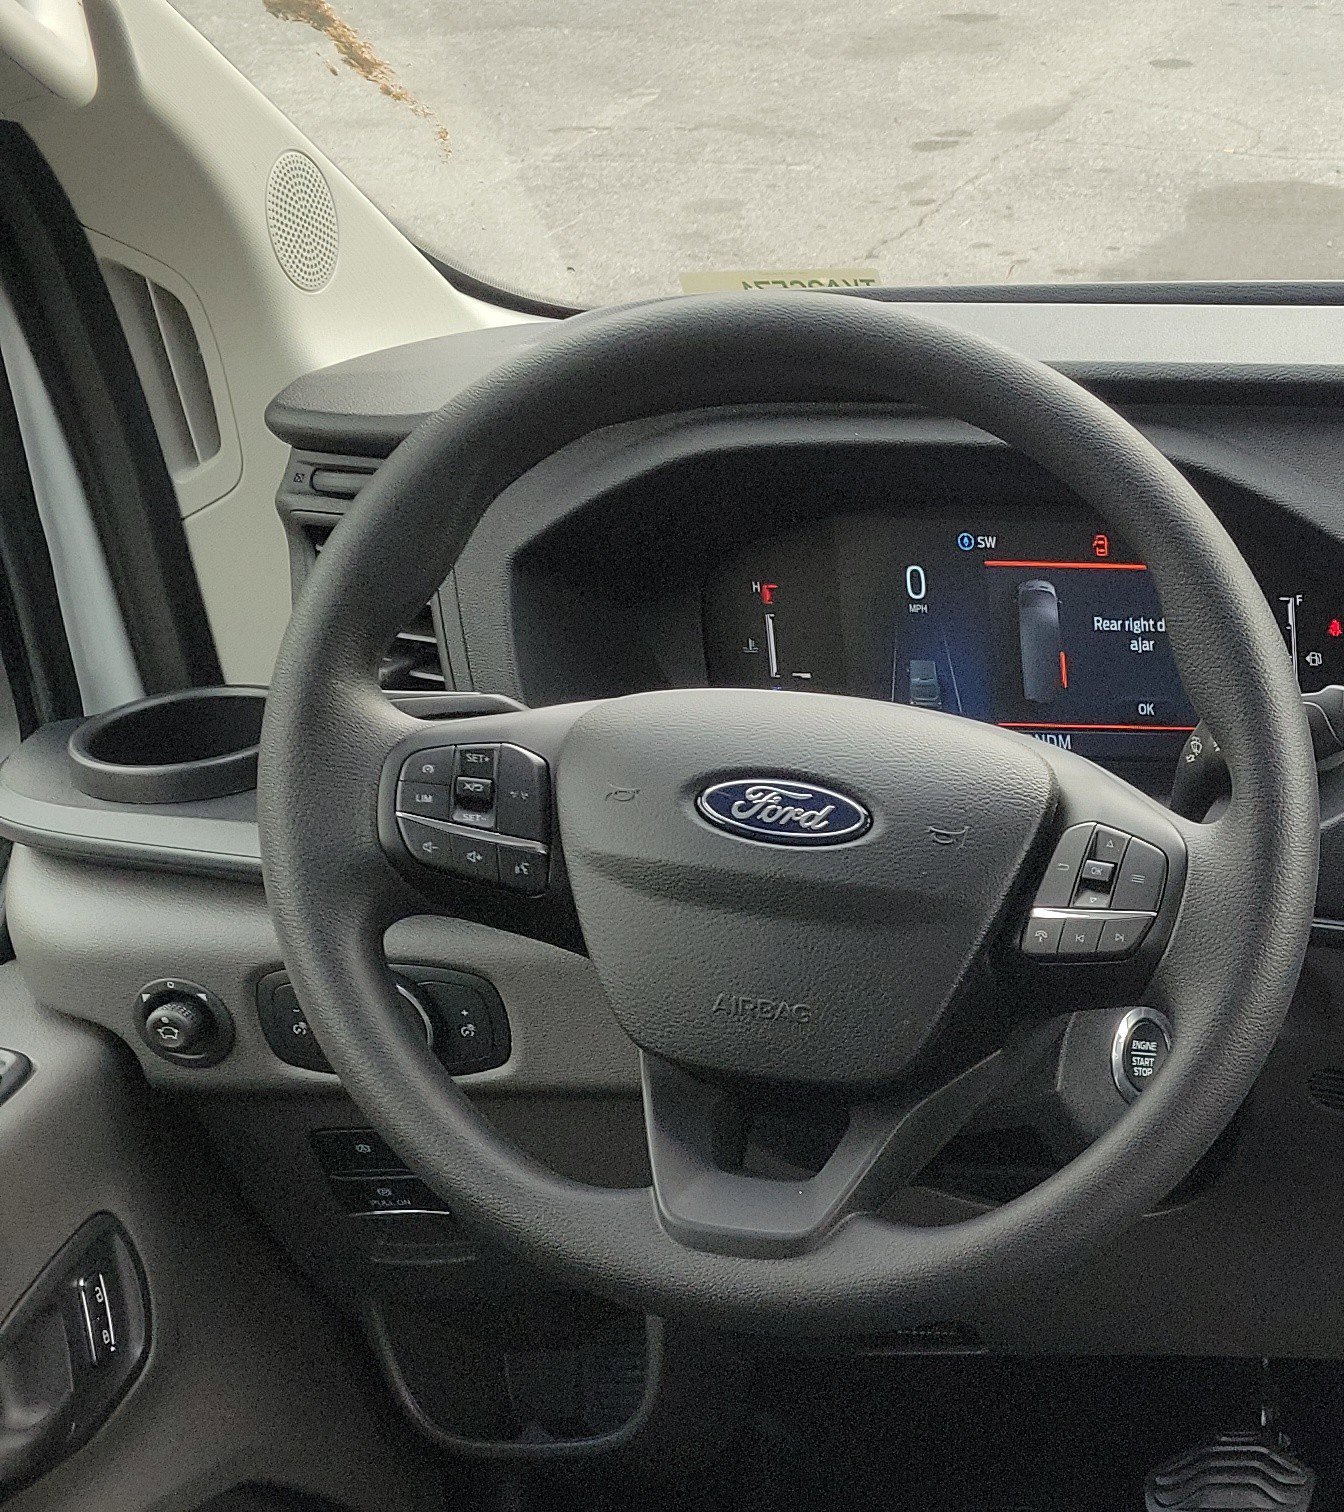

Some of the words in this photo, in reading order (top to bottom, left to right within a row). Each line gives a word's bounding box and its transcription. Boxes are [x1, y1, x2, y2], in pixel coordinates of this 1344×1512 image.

[976, 536, 997, 549] SW
[752, 582, 761, 592] H
[908, 604, 928, 615] MPH
[1093, 616, 1122, 632] Rear
[1124, 616, 1155, 635] right
[1129, 638, 1155, 654] ajar
[1137, 703, 1155, 716] OK
[731, 785, 835, 830] Ford
[712, 992, 811, 1022] AIRBAG
[1131, 1040, 1158, 1051] ENGINE
[1131, 1057, 1155, 1067] START
[1133, 1067, 1153, 1077] STOP
